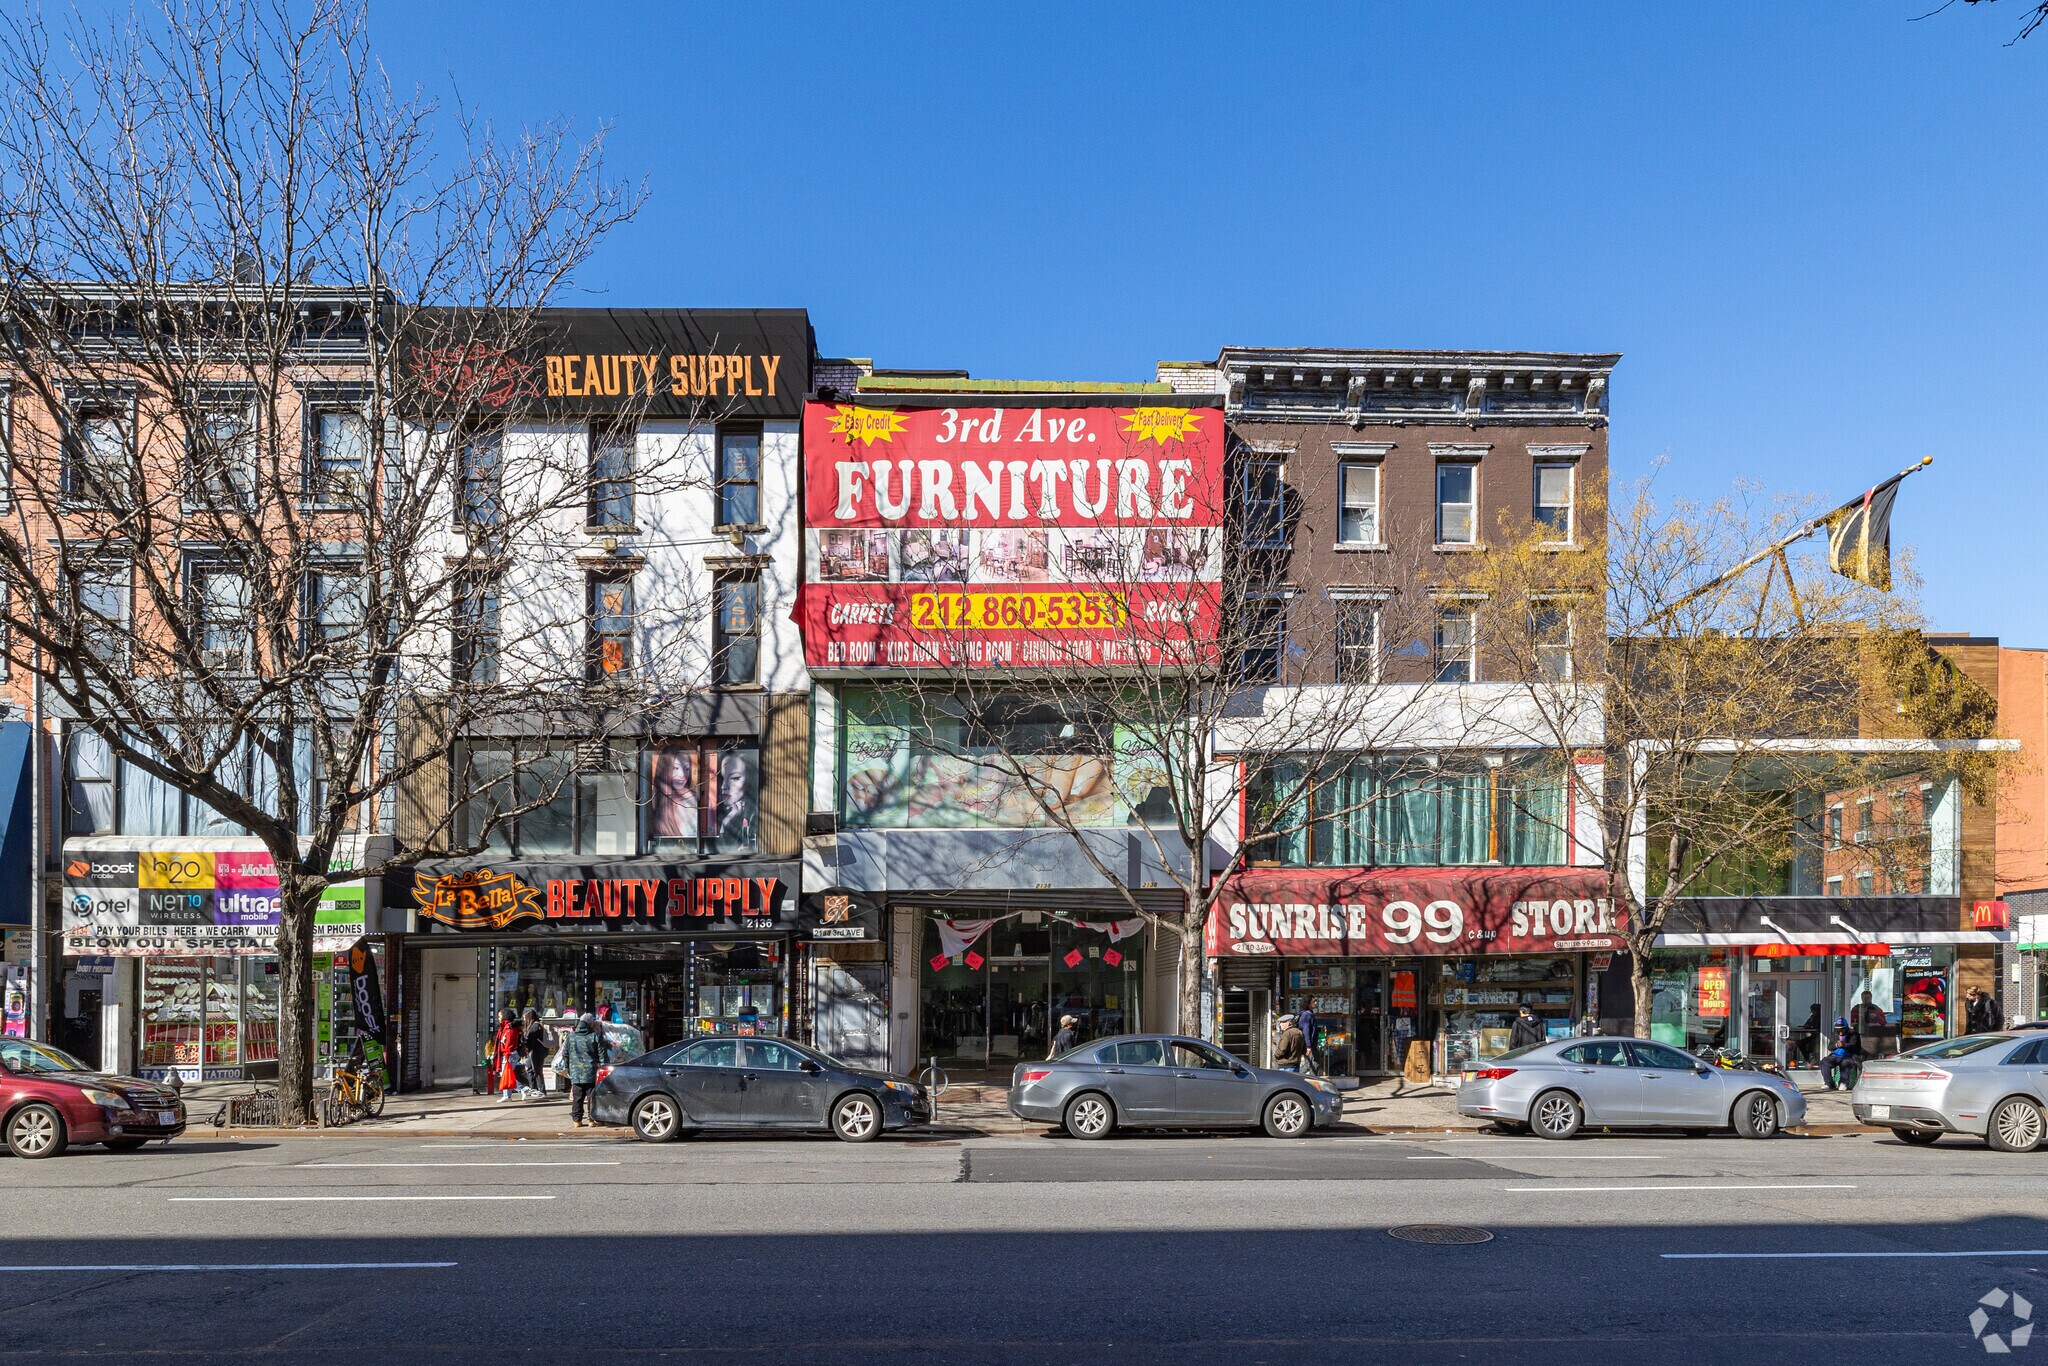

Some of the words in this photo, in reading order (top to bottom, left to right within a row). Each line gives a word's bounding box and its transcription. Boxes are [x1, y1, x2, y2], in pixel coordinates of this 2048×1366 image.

[546, 355, 658, 396] BEAUTY
[670, 355, 781, 396] SUPPLY
[845, 413, 864, 434] Easy
[866, 413, 891, 430] Credit
[936, 408, 1002, 443] 3rd
[1014, 408, 1096, 443] Ave.
[1138, 411, 1154, 426] Fast
[1155, 410, 1184, 429] Delivery
[834, 458, 1194, 520] FURNITURE
[831, 603, 896, 625] CARPETS
[917, 596, 972, 626] 212
[828, 641, 846, 662] BED
[849, 641, 876, 662] ROOM
[887, 641, 909, 662] KIDS
[913, 641, 939, 662] ROOM
[986, 641, 1012, 661] ROOM
[1066, 640, 1092, 661] ROOM
[91, 862, 134, 873] boost
[329, 860, 353, 872] yca
[220, 893, 270, 913] ultra
[336, 900, 360, 910] Mobile
[437, 889, 456, 907] La
[458, 888, 512, 915] Bella
[546, 879, 660, 918] BEAUTY
[667, 877, 777, 917] SUPPLY
[97, 899, 130, 916] ptel
[241, 912, 268, 921] mobile
[746, 919, 772, 928] 2136
[1230, 903, 1366, 939] SUNRISE
[1382, 900, 1464, 944] 99
[1511, 899, 1616, 937] STORE
[97, 925, 114, 936] PAY
[117, 925, 140, 936] YOUR
[143, 925, 167, 936] BILLS
[174, 925, 197, 936] HERE
[206, 925, 218, 936] WE
[223, 925, 250, 936] CARRY
[257, 925, 279, 936] UNLO
[313, 926, 324, 935] SM
[327, 924, 362, 934] PHONES
[832, 929, 844, 937] 3rd
[846, 928, 863, 937] AVE.
[1485, 930, 1497, 940] up
[69, 937, 129, 948] BLOW
[136, 938, 179, 948] OUT
[186, 937, 271, 948] SPECIAL
[77, 965, 91, 973] BODY
[92, 965, 113, 973] PIERCING
[1703, 980, 1726, 990] OPEN
[1754, 983, 1760, 991] A
[356, 974, 381, 1033] boost
[1703, 1000, 1726, 1009] Hours
[1709, 991, 1720, 1000] 24
[141, 1070, 199, 1081] TATOO
[204, 1069, 240, 1080] TATTOO
